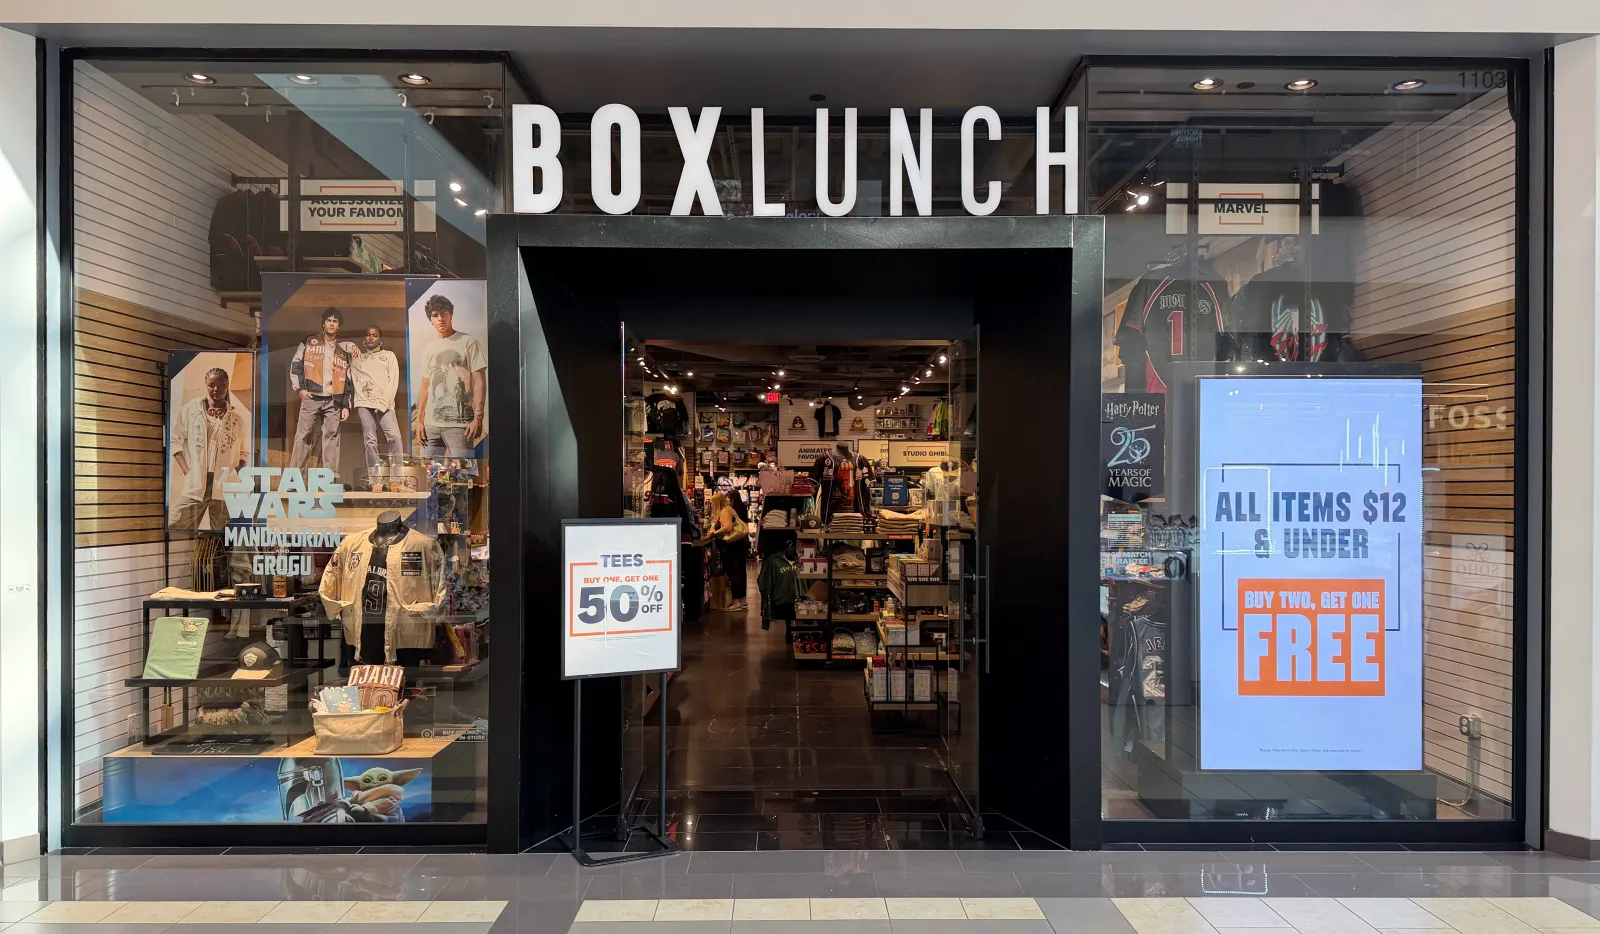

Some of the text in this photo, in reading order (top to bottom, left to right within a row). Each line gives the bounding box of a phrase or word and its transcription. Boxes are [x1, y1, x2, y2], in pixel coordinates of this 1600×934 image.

[1458, 70, 1506, 89] 1103
[308, 207, 346, 218] YOUR
[1213, 203, 1269, 214] MARVEL
[1167, 310, 1184, 356] 1
[767, 392, 780, 402] EXIT
[1104, 400, 1160, 420] Harry Potter
[1107, 426, 1153, 467] 25
[223, 466, 344, 493] STAR
[1108, 468, 1152, 476] YEARS OF
[1108, 476, 1152, 487] MAGIC
[223, 492, 344, 519] WARS
[1214, 489, 1407, 525] ALL ITEMS $12
[224, 526, 341, 547] MANDALORIAN
[1254, 528, 1369, 559] & UNDER
[253, 555, 312, 577] GROGU
[600, 553, 644, 568] TEES
[583, 576, 600, 584] BUY
[624, 575, 640, 583] GET
[642, 574, 660, 582] ONE
[641, 604, 663, 614] OFF
[1244, 590, 1380, 610] BUY TWO, GET ONE
[1243, 613, 1380, 682] FREE
